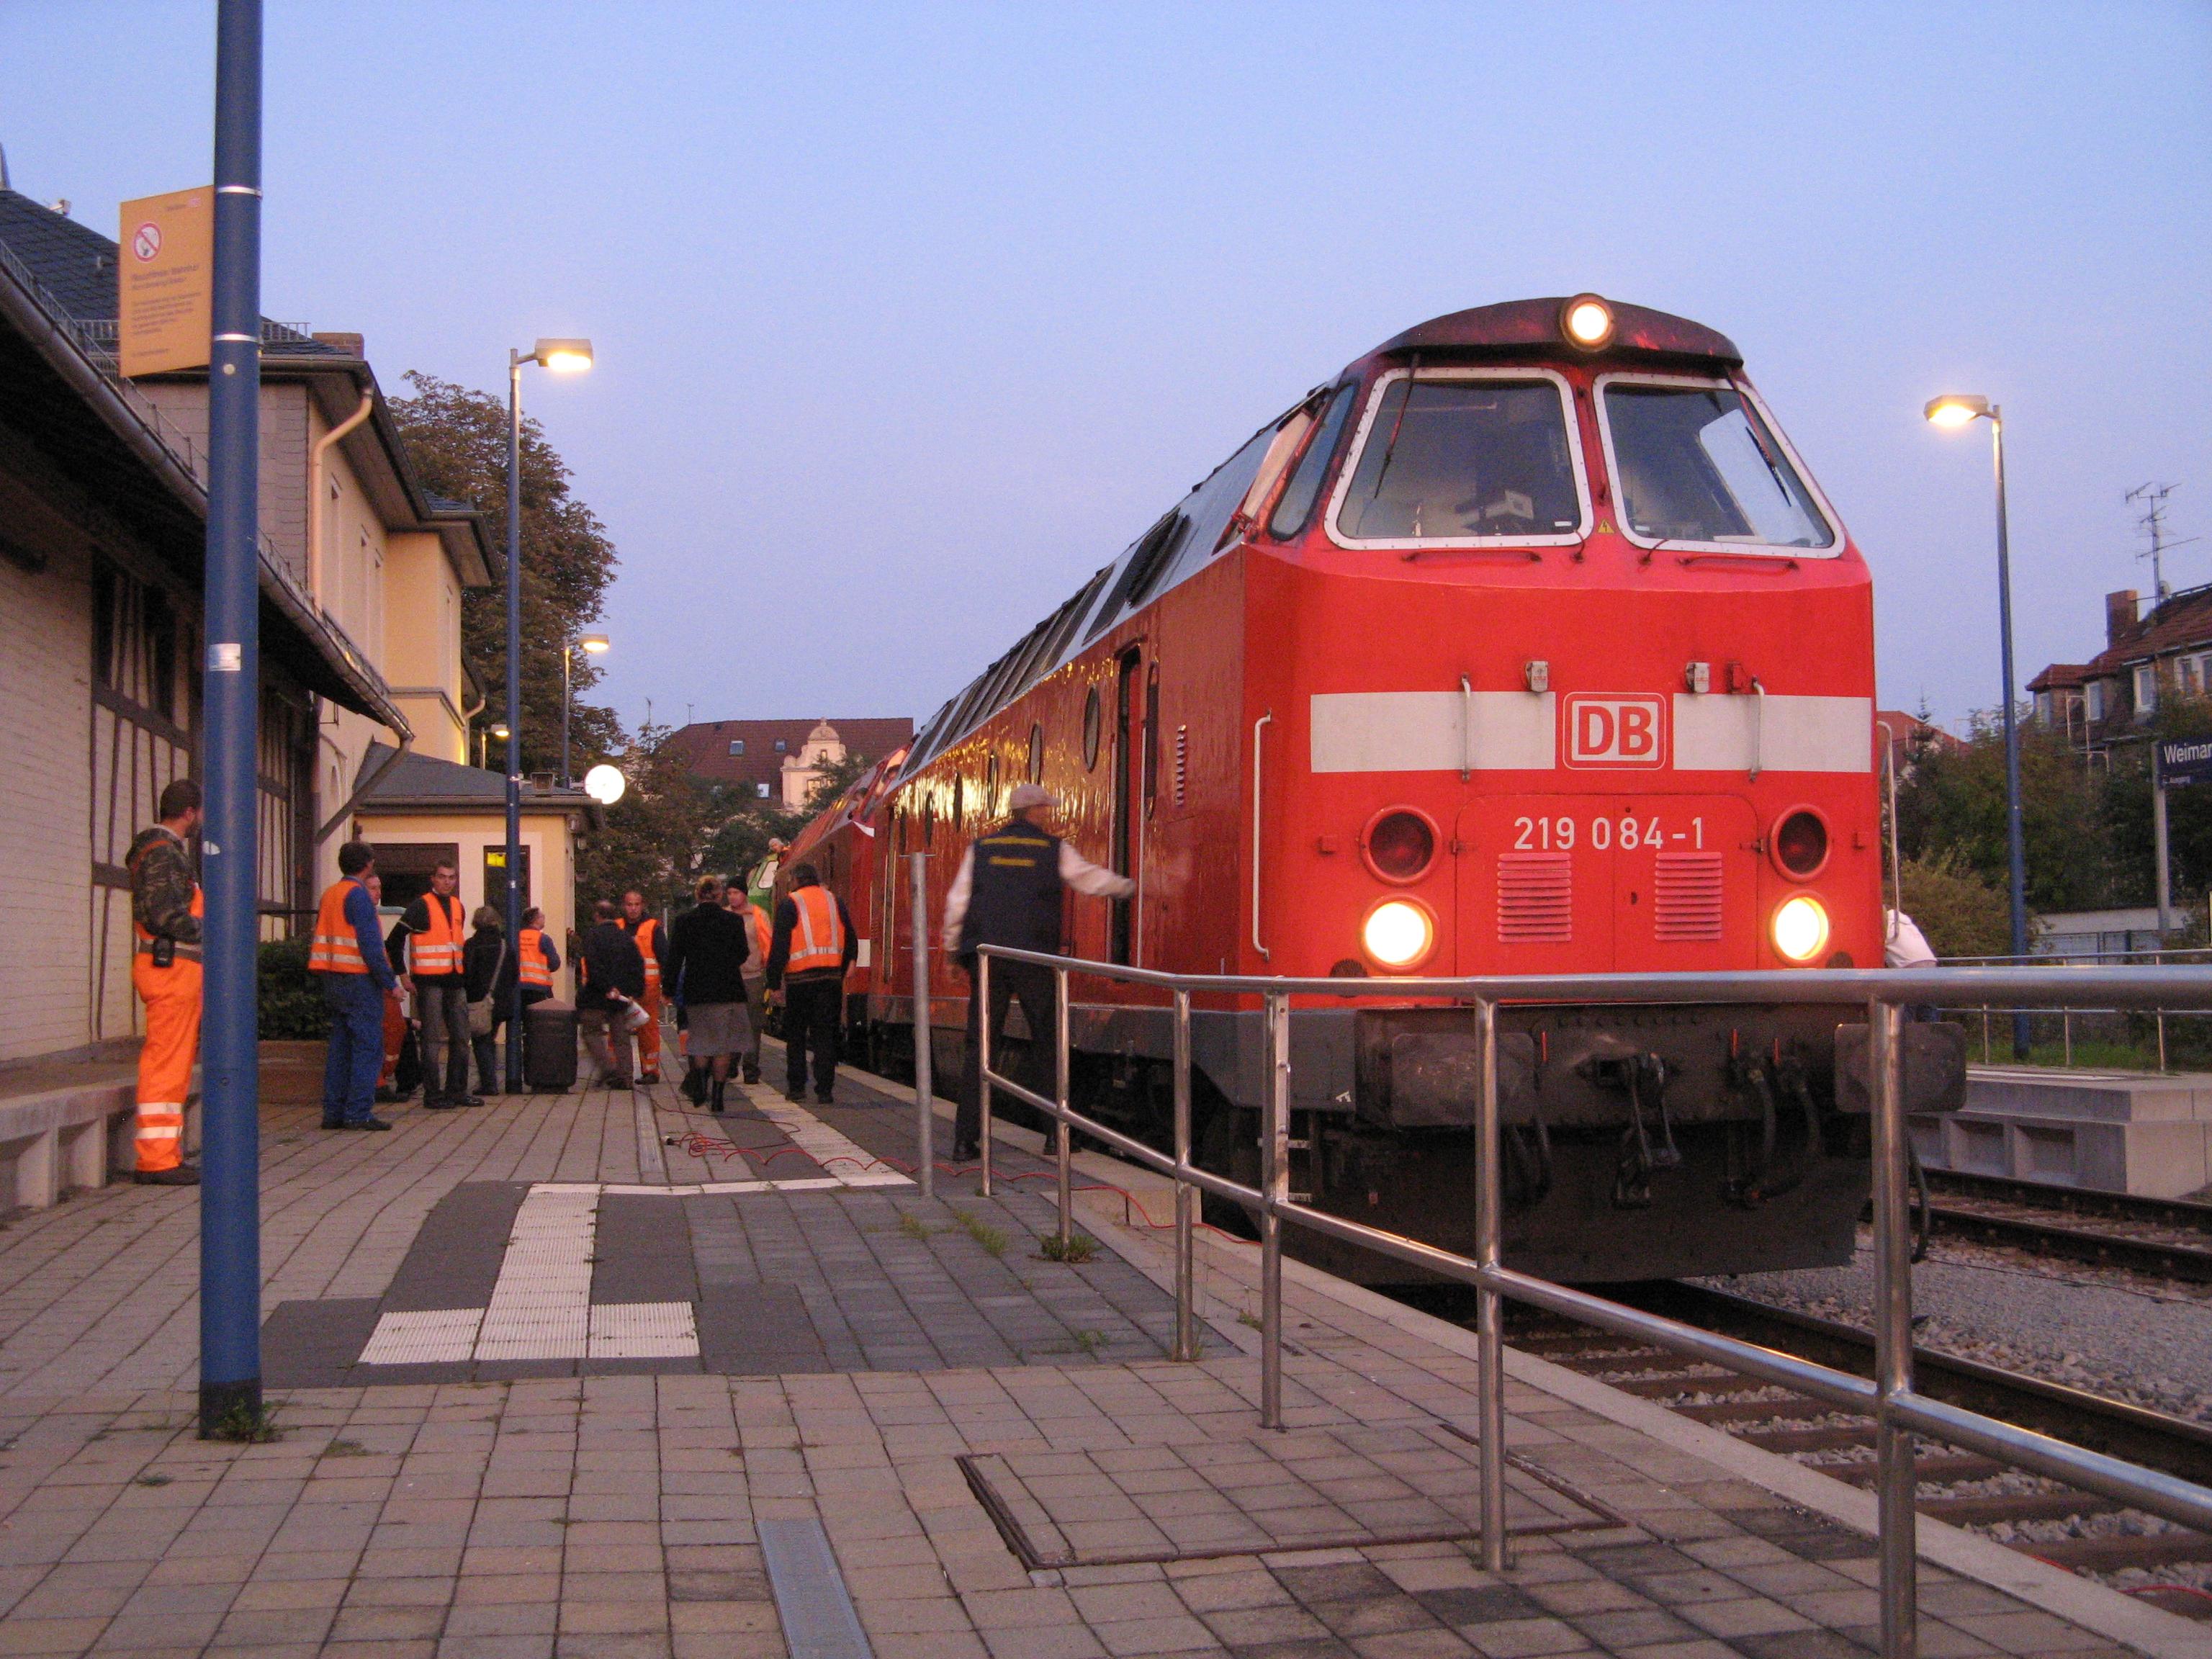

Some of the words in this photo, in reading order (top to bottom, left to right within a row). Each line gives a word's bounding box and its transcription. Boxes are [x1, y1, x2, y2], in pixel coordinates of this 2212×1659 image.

[1578, 706, 1653, 756] DB
[1514, 817, 1575, 850] 219
[1591, 817, 1703, 850] 084-1
